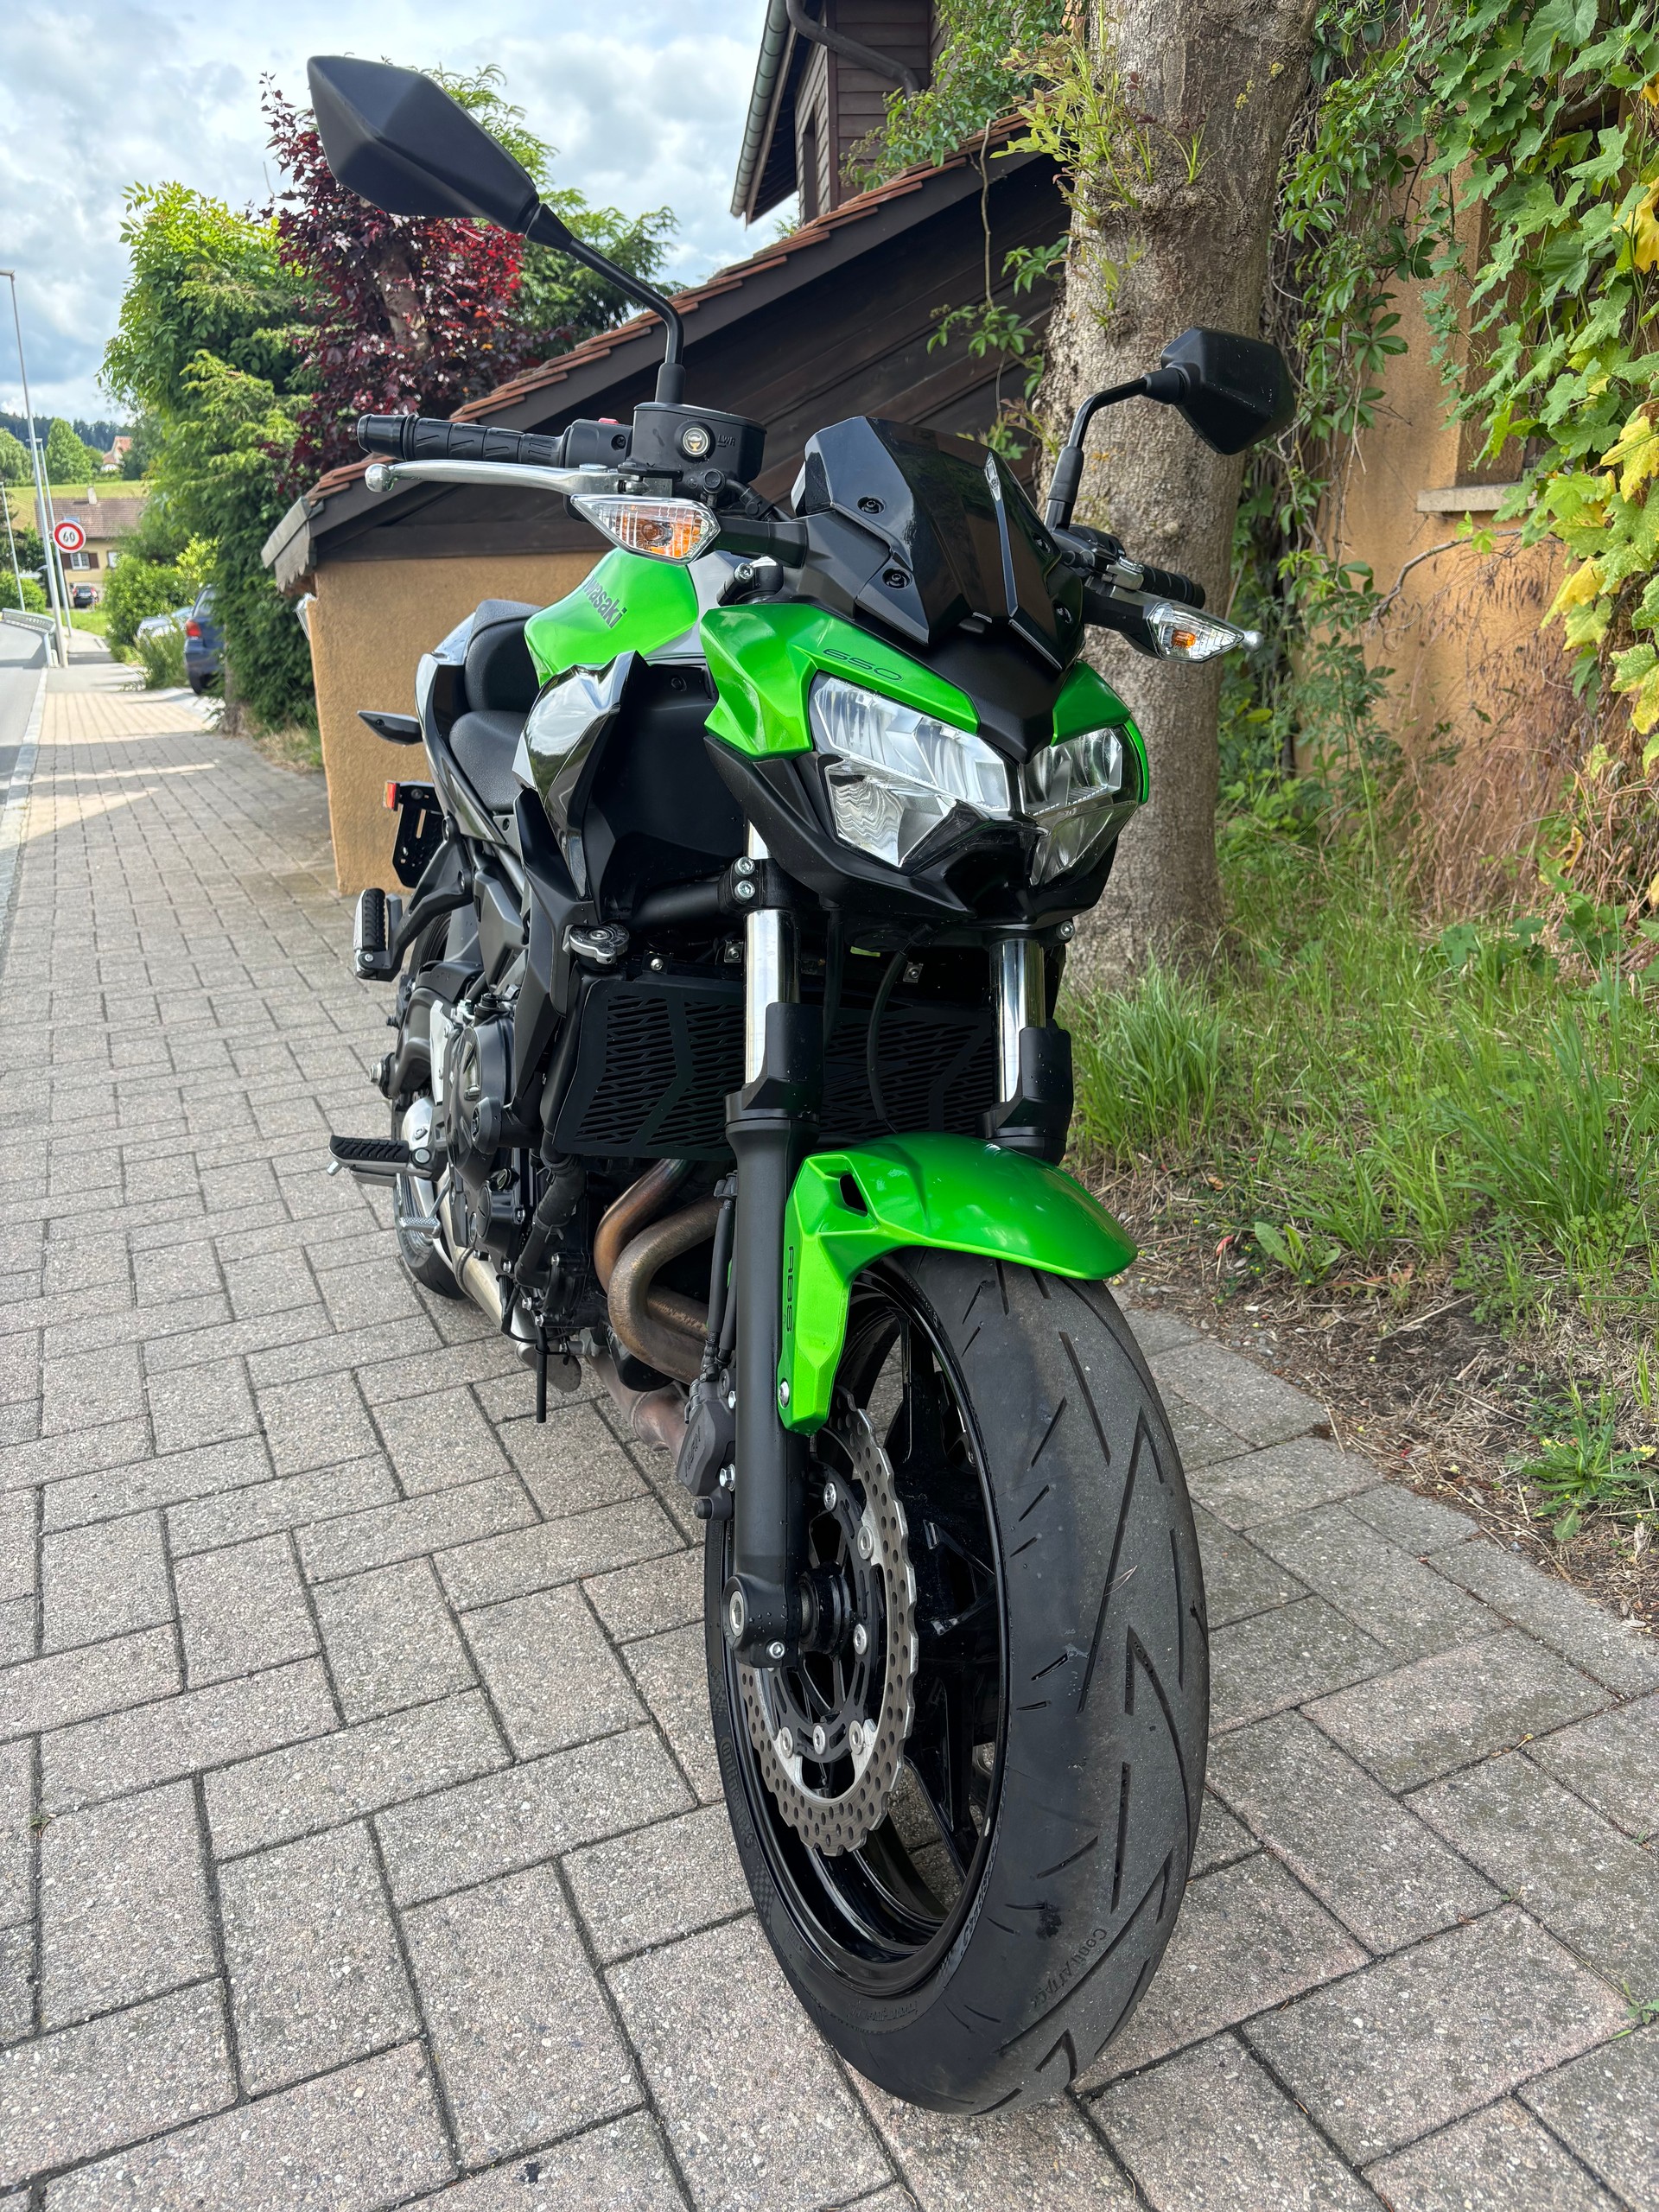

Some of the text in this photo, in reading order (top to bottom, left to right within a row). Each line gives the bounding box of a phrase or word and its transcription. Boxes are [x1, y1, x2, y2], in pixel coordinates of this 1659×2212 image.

[716, 433, 737, 447] LWR
[63, 531, 75, 543] 60
[583, 574, 628, 629] wasaki
[823, 648, 902, 681] 650
